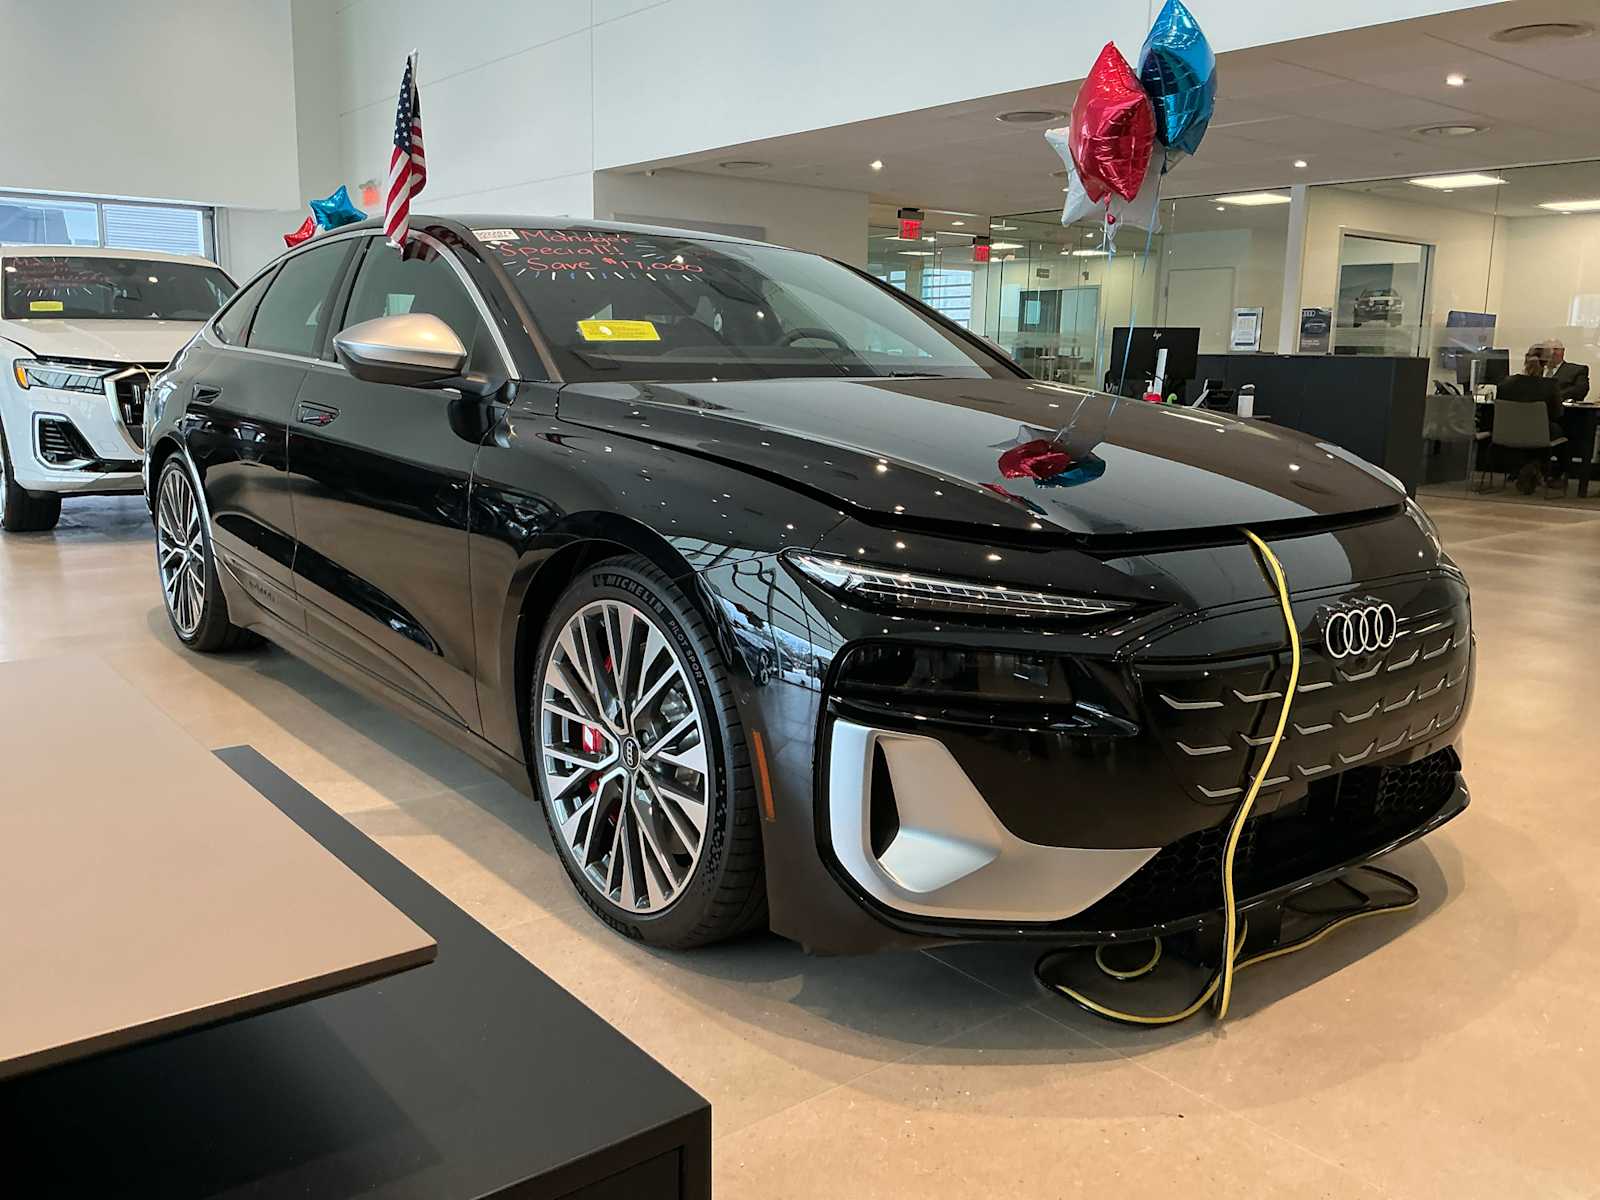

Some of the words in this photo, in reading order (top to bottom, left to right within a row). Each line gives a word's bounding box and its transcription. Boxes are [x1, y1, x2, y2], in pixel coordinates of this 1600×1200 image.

[527, 257, 600, 271] Save
[602, 257, 704, 273] $17,000
[606, 574, 665, 614] MICHELIN
[668, 620, 689, 647] PILOT
[686, 649, 706, 686] SPORT
